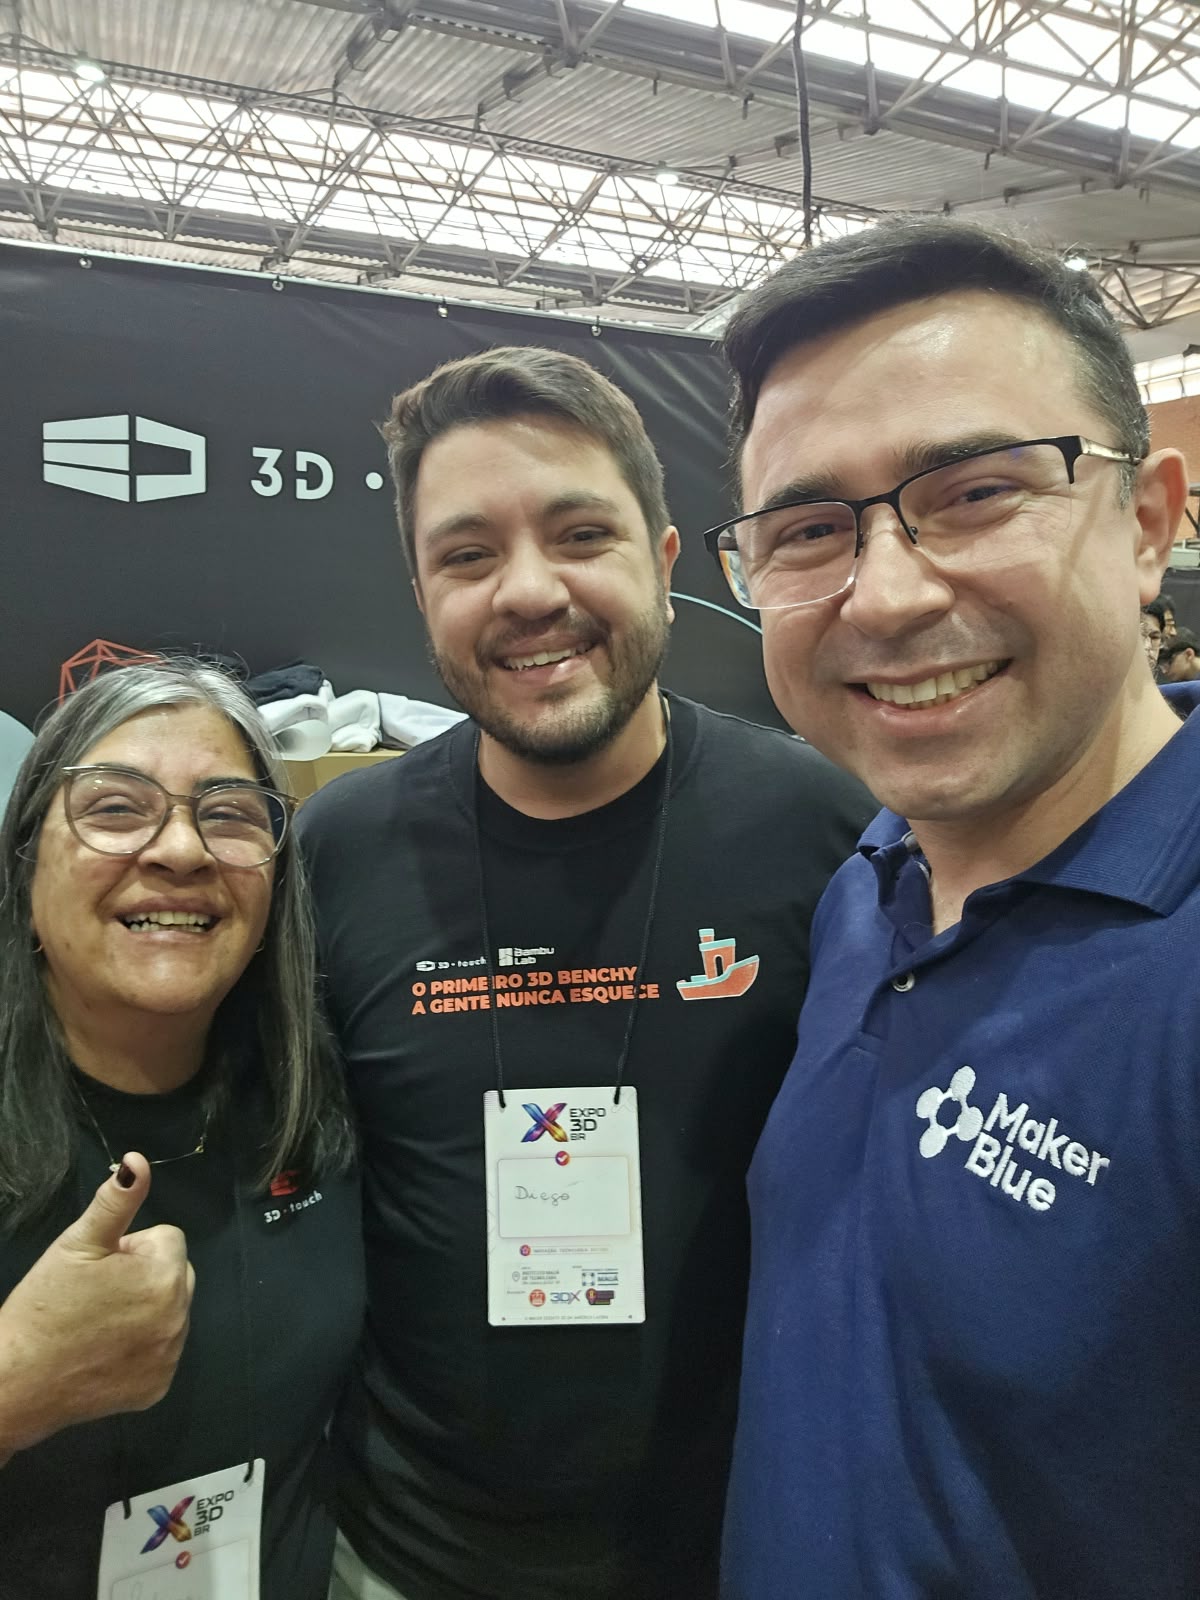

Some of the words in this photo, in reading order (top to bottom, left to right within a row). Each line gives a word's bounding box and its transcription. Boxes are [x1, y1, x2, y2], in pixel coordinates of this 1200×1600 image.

[251, 447, 334, 500] 3D
[515, 956, 536, 965] Lab
[412, 982, 426, 997] O
[527, 971, 553, 987] 3D
[557, 966, 638, 985] BENCHY
[412, 1000, 426, 1015] A
[430, 995, 490, 1014] GENTE
[496, 989, 566, 1008] NUNCA
[570, 1107, 606, 1118] EXPO
[570, 1118, 597, 1132] 3D
[570, 1132, 586, 1141] BR
[982, 1092, 1111, 1187] Maker
[964, 1131, 1056, 1212] Blue
[264, 1209, 281, 1223] 3D
[289, 1190, 323, 1212] touch
[196, 1490, 234, 1511] EXPO
[194, 1505, 223, 1527] 3D
[193, 1524, 210, 1537] BR
